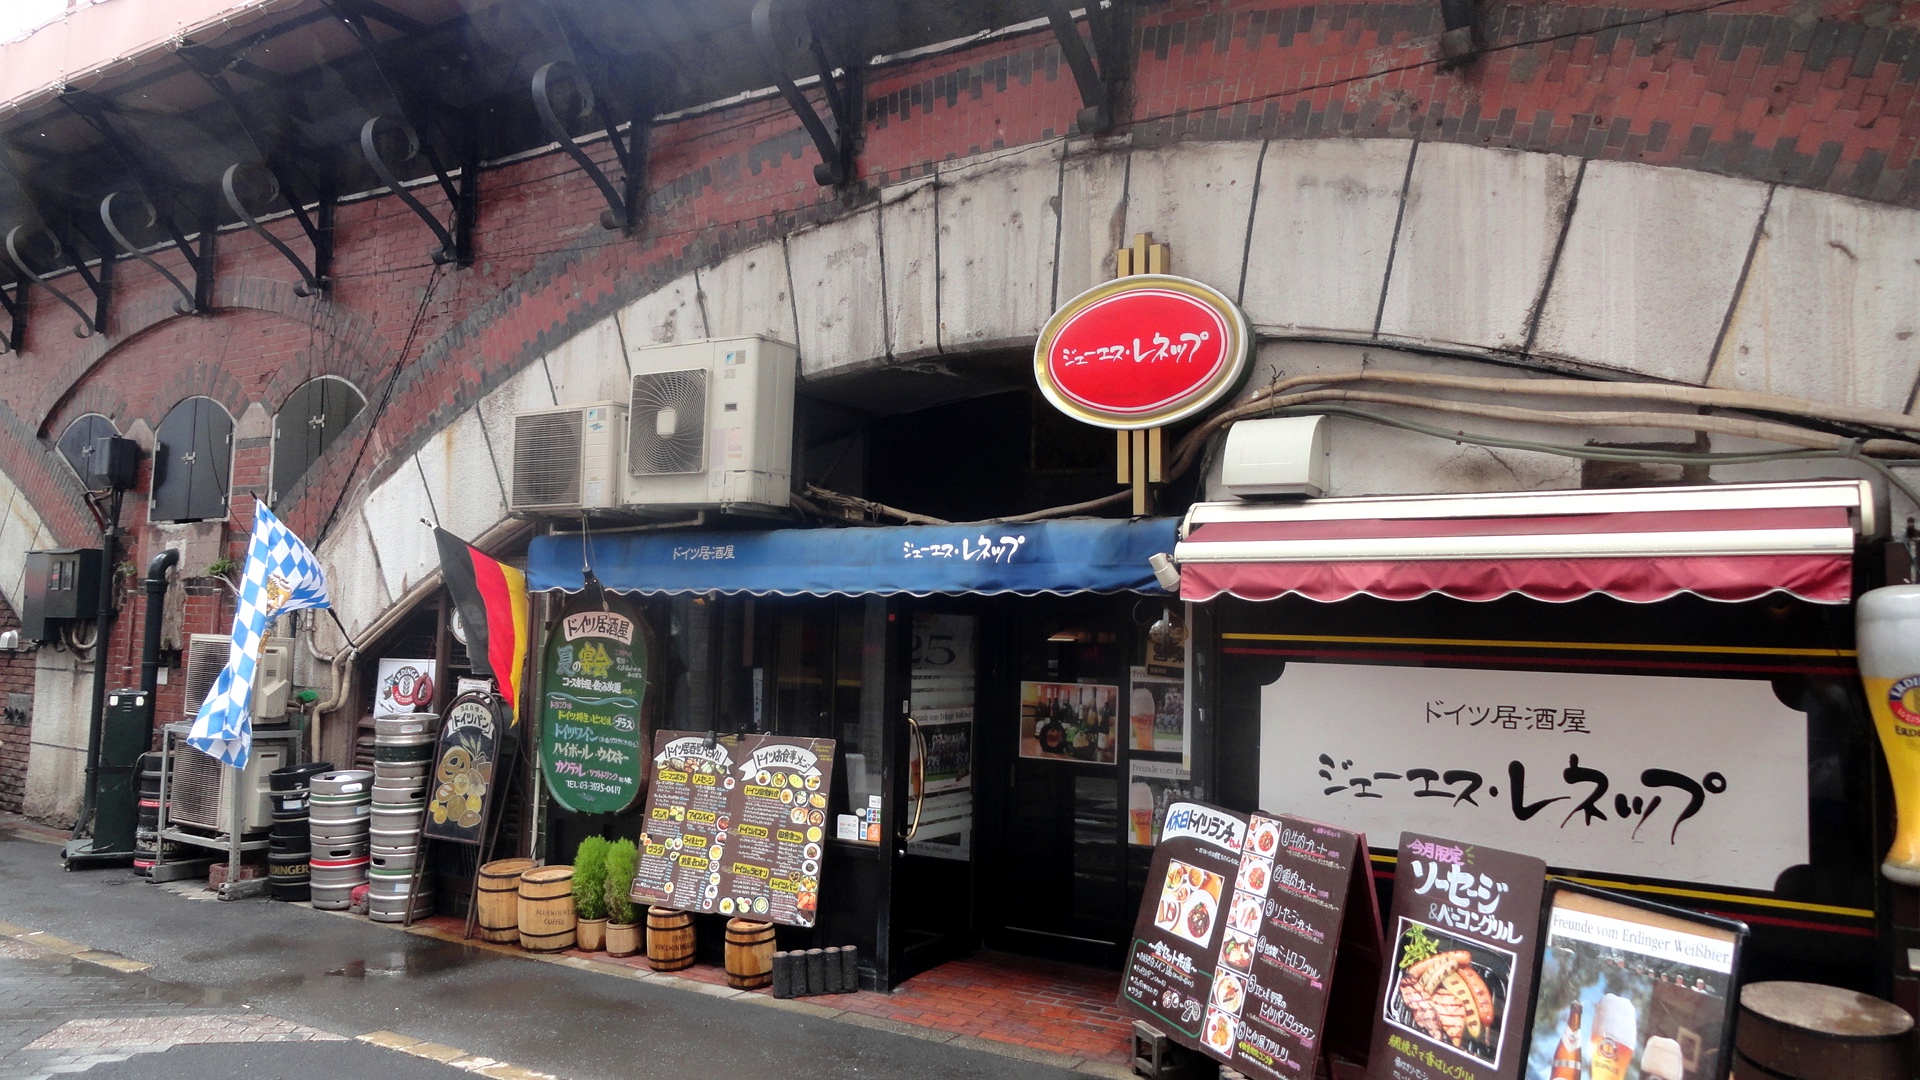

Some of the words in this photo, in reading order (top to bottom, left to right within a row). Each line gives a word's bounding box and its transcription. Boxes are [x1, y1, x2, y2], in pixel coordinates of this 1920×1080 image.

[1062, 331, 1210, 367] ジェーエス・レネップ
[673, 544, 735, 560] ドイツ居酒屋
[903, 534, 1026, 564] ジェーエス・レネップ
[567, 615, 629, 640] ドイツ居酒屋
[453, 712, 490, 729] ドイツパン
[1424, 700, 1591, 735] ドイツ居酒屋
[1317, 753, 1727, 845] ジェーエス・レネップ
[1406, 838, 1465, 866] 今月限定
[1410, 860, 1509, 914] ソーセージ
[1552, 914, 1594, 935] Freunde
[1596, 926, 1619, 940] vom
[1622, 928, 1671, 952] Erdinger
